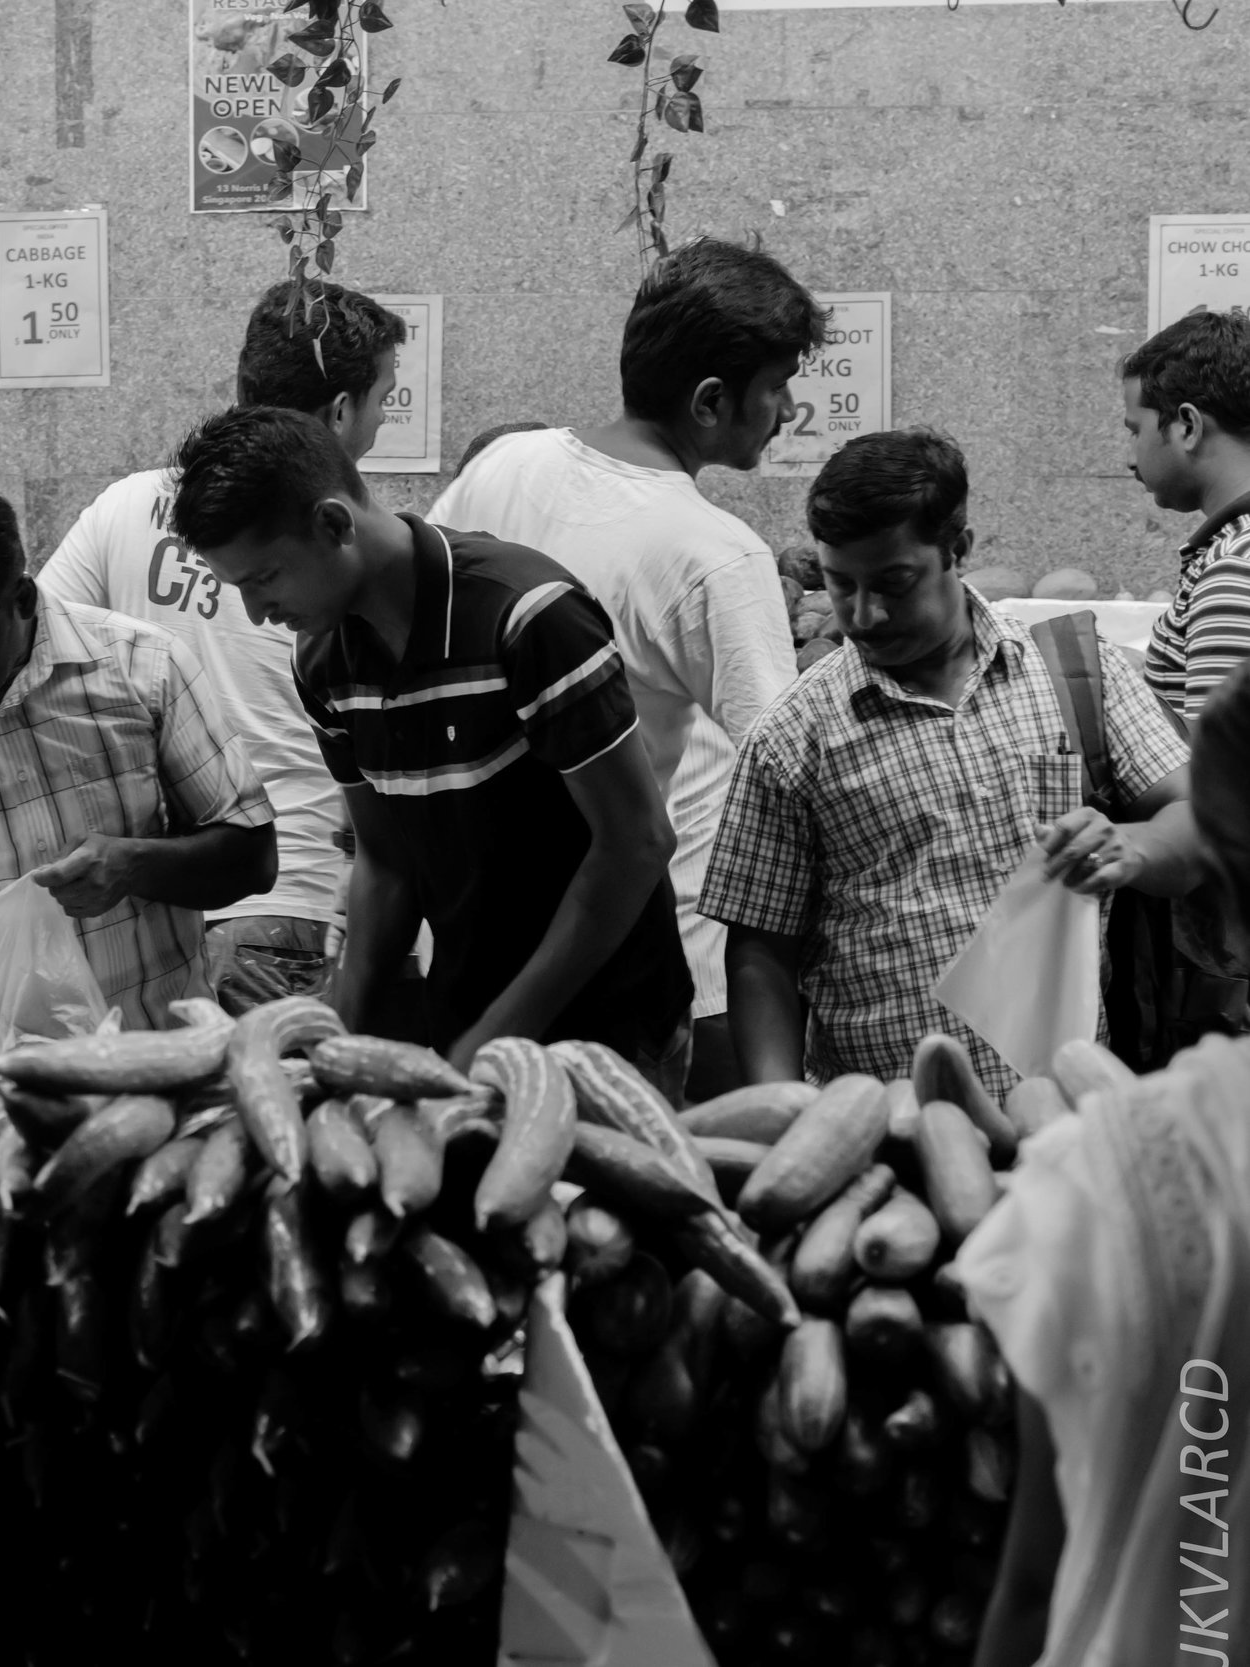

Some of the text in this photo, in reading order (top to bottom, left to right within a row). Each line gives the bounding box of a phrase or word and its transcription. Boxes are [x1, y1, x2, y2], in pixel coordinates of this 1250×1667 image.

[6, 246, 86, 262] CABBAGE
[1167, 241, 1217, 254] CHOW
[1199, 263, 1239, 277] 1-KG
[25, 272, 68, 289] 1-KG
[49, 329, 80, 339] ONLY
[798, 358, 852, 378] 1-KG
[828, 420, 862, 432] ONLY
